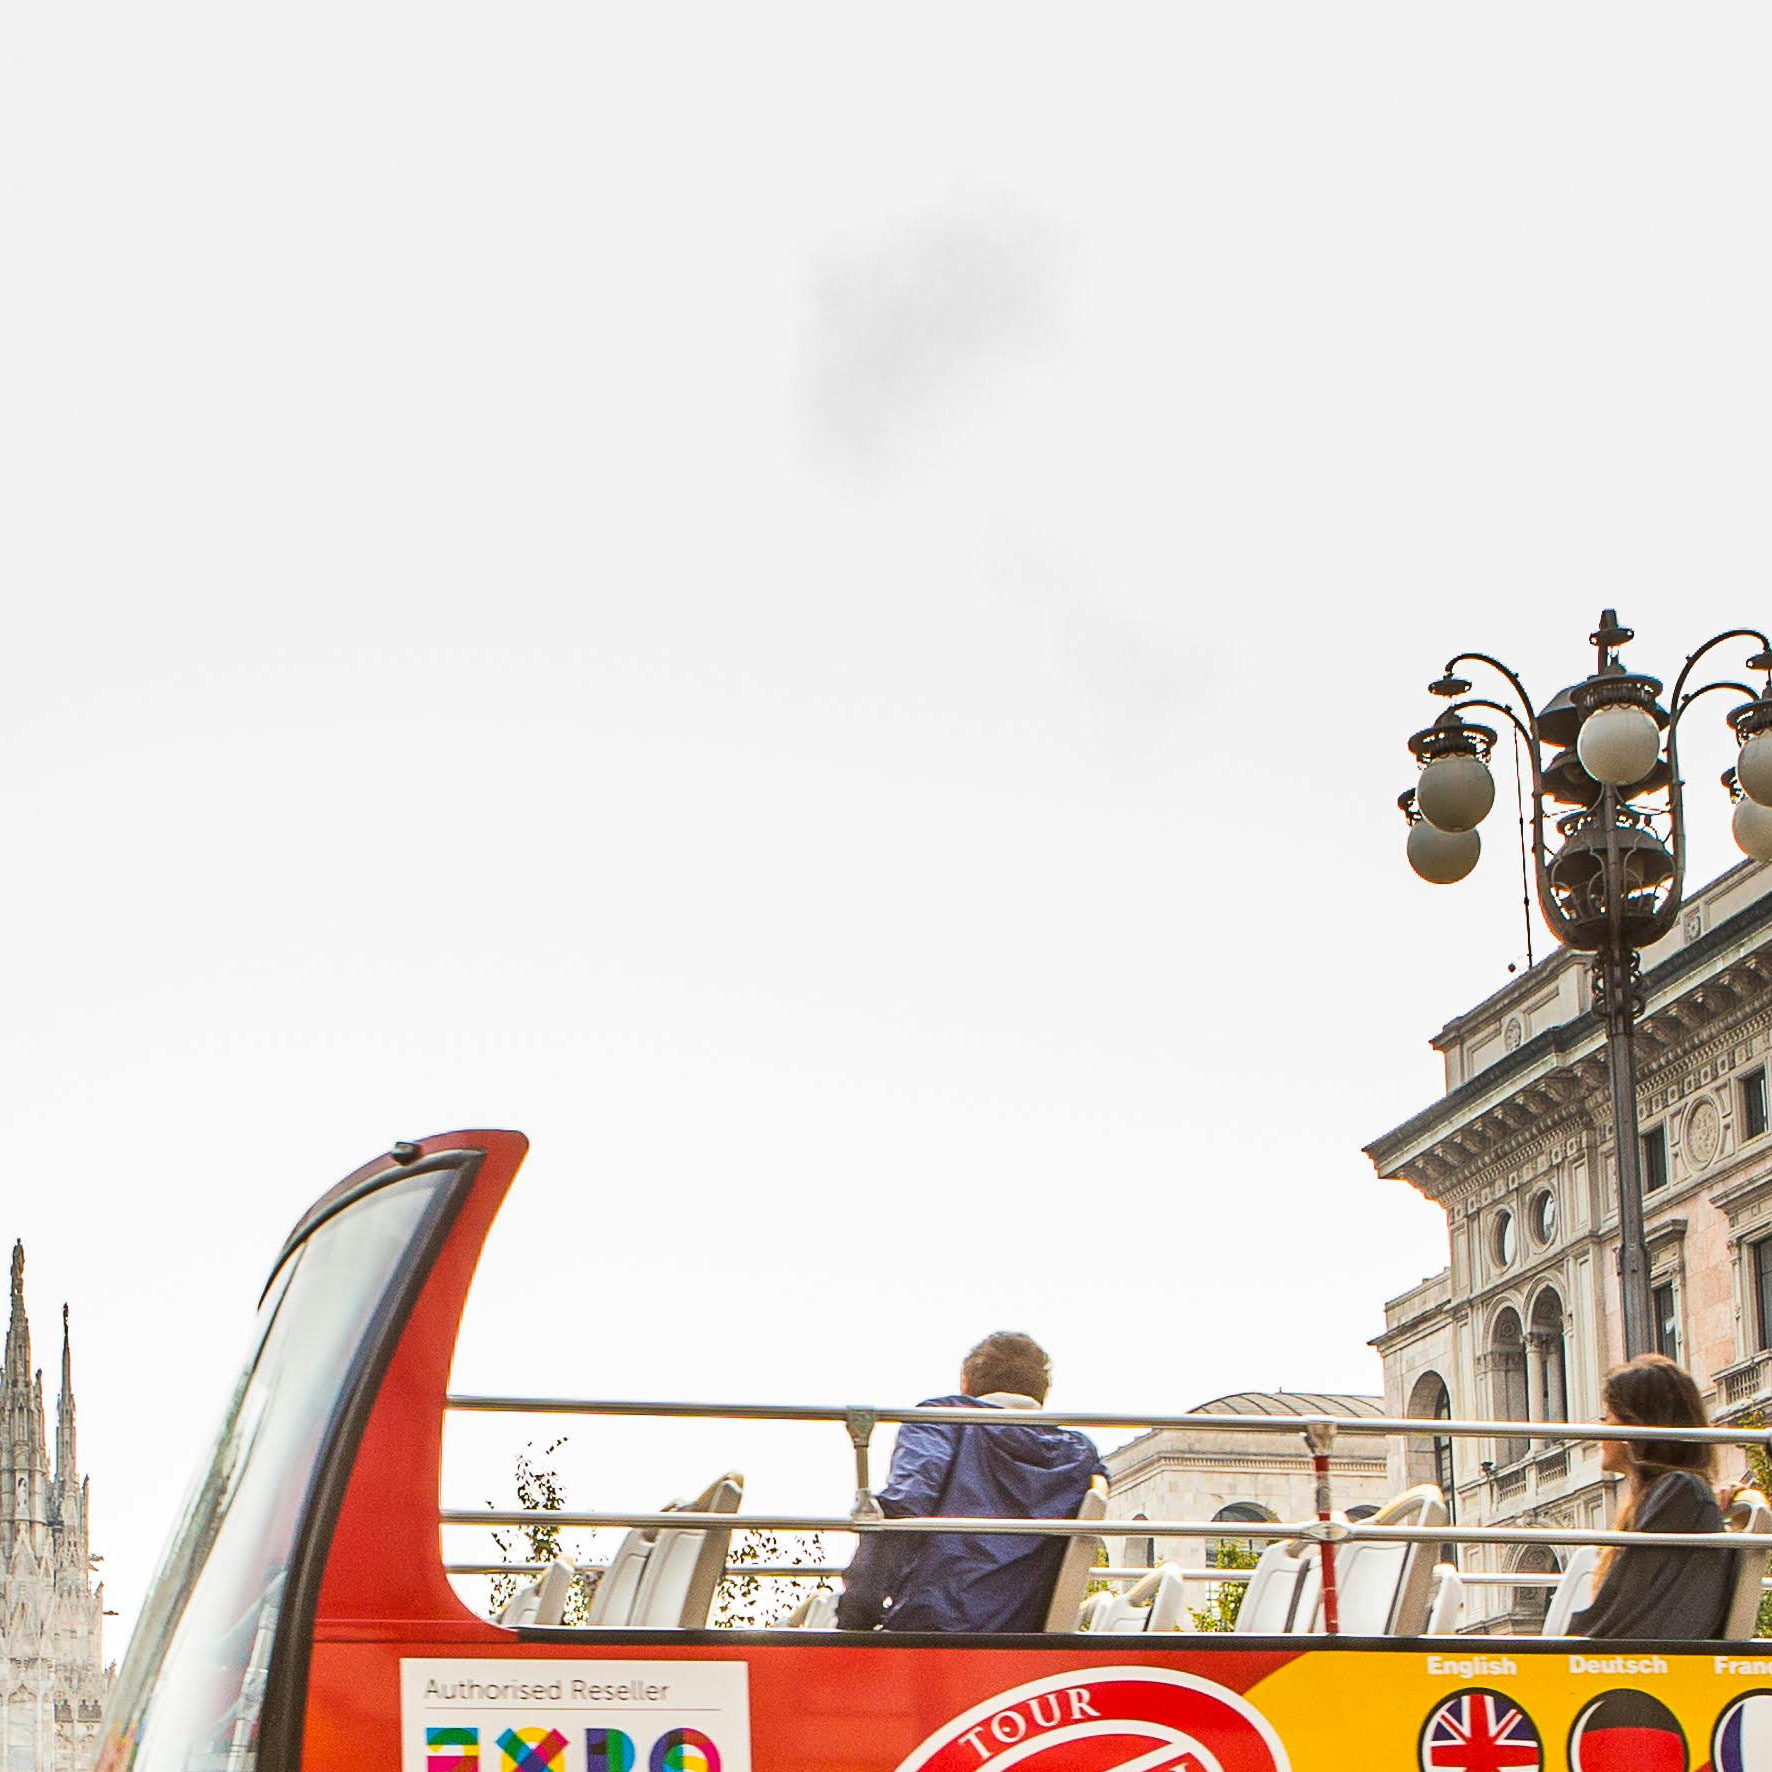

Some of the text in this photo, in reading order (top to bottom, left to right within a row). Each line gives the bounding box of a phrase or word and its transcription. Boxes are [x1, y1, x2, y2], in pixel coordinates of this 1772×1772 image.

[1427, 1655, 1517, 1680] English
[1568, 1654, 1668, 1675] Deutsch
[425, 1679, 670, 1702] Authorised Reseller
[957, 1686, 1102, 1763] TOUR
